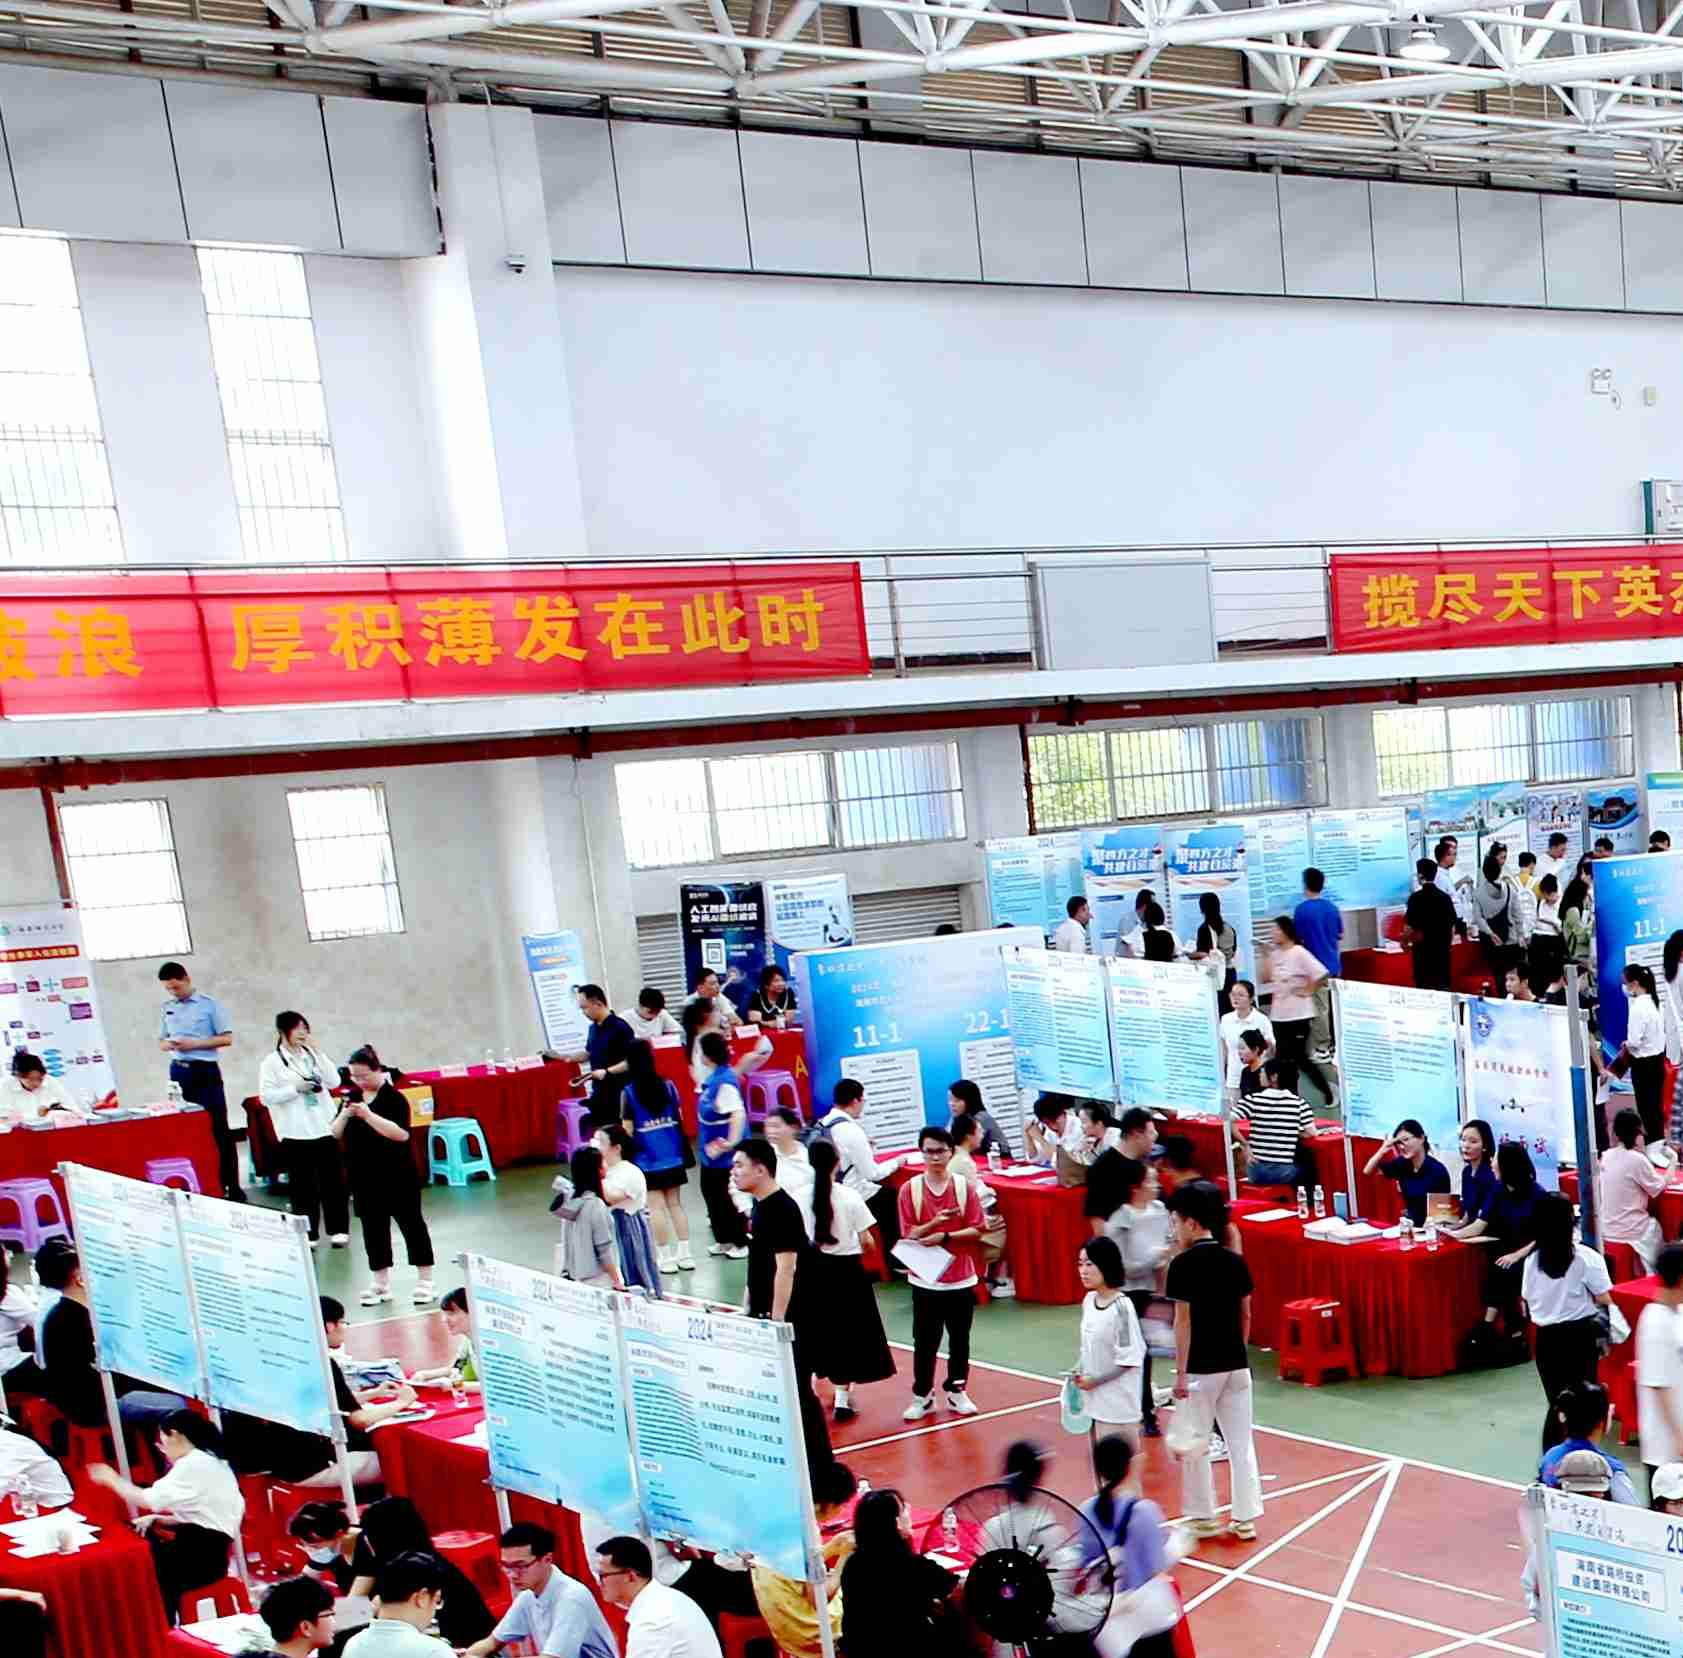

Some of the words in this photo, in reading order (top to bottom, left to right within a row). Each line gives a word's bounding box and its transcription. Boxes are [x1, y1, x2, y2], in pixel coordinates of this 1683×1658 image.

[232, 589, 824, 673] 厚积薄发在此时
[966, 1007, 1009, 1033] 22-1
[687, 1317, 713, 1342] 2024
